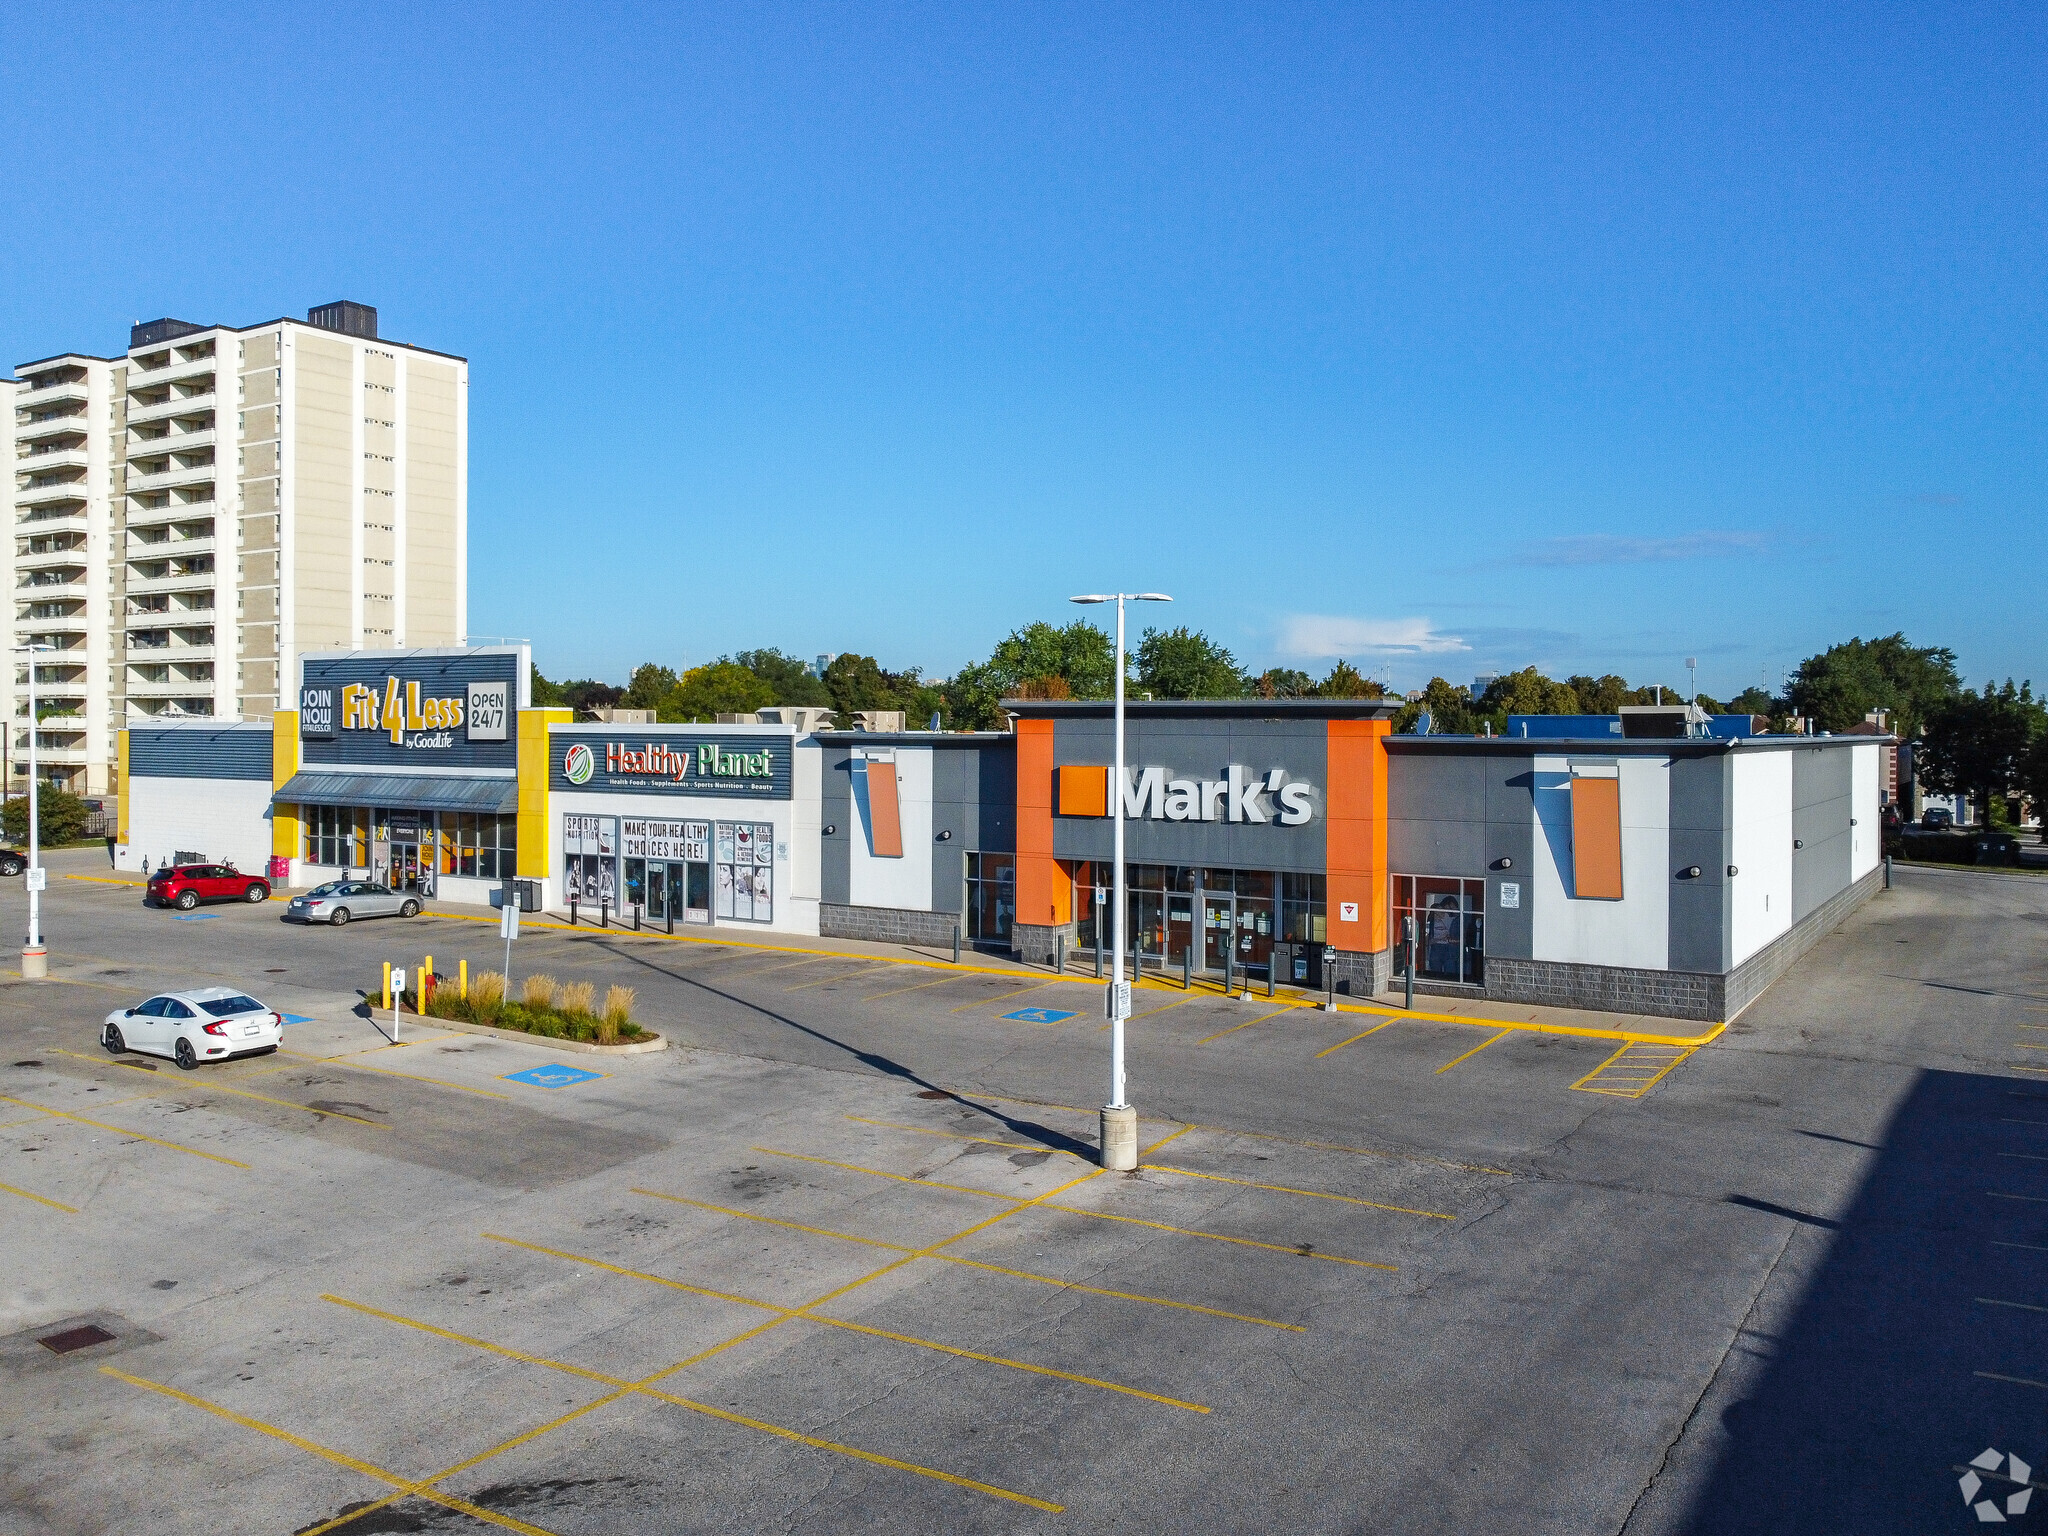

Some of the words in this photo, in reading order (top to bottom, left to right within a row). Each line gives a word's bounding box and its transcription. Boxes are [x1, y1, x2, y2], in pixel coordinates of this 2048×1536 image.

[302, 690, 332, 707] JOIN
[471, 693, 504, 708] OPEN
[302, 708, 332, 724] NOW
[471, 710, 504, 728] 24/7
[406, 739, 414, 749] by
[414, 732, 453, 748] GoodLife
[606, 742, 690, 781] Healthy
[698, 744, 773, 777] Planet
[651, 780, 689, 788] Supplements
[694, 781, 713, 789] Sports
[751, 783, 773, 791] Beauty
[1107, 765, 1312, 825] Mark's
[567, 817, 599, 831] SPORTS
[624, 822, 646, 836] MAKE
[649, 823, 667, 837] YOUR
[669, 824, 708, 839] HEALTHY
[673, 842, 703, 858] HERE!
